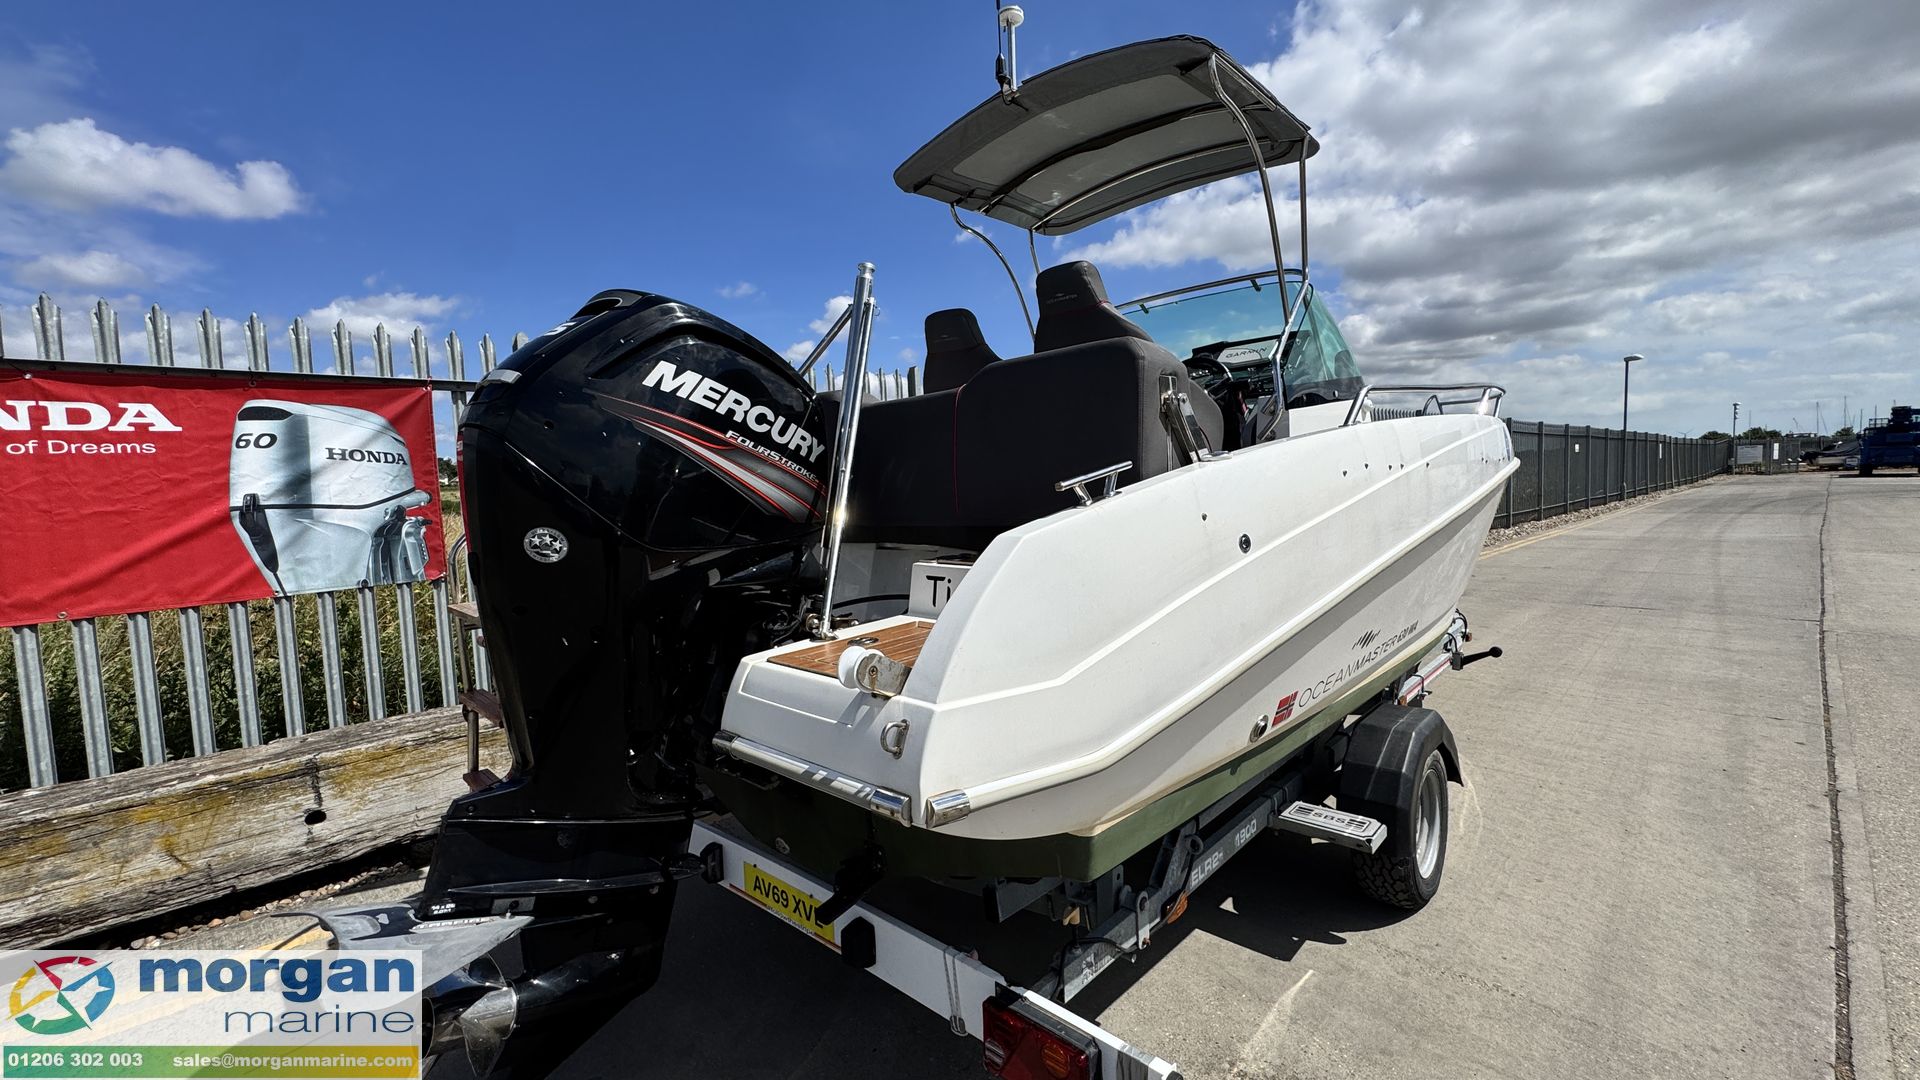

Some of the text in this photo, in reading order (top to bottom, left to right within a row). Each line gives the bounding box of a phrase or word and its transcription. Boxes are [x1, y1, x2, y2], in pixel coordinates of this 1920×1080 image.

[1225, 347, 1268, 359] GARMIN
[643, 361, 825, 462] MERCURY
[6, 440, 156, 455] of Dreams
[235, 433, 277, 449] 60
[325, 446, 408, 466] HONDA
[725, 430, 819, 482] FOURSTROKE
[1299, 634, 1397, 707] OCEANMASTER
[1311, 811, 1347, 824] SBS
[1234, 819, 1257, 846] 1900
[753, 875, 790, 908] AV69
